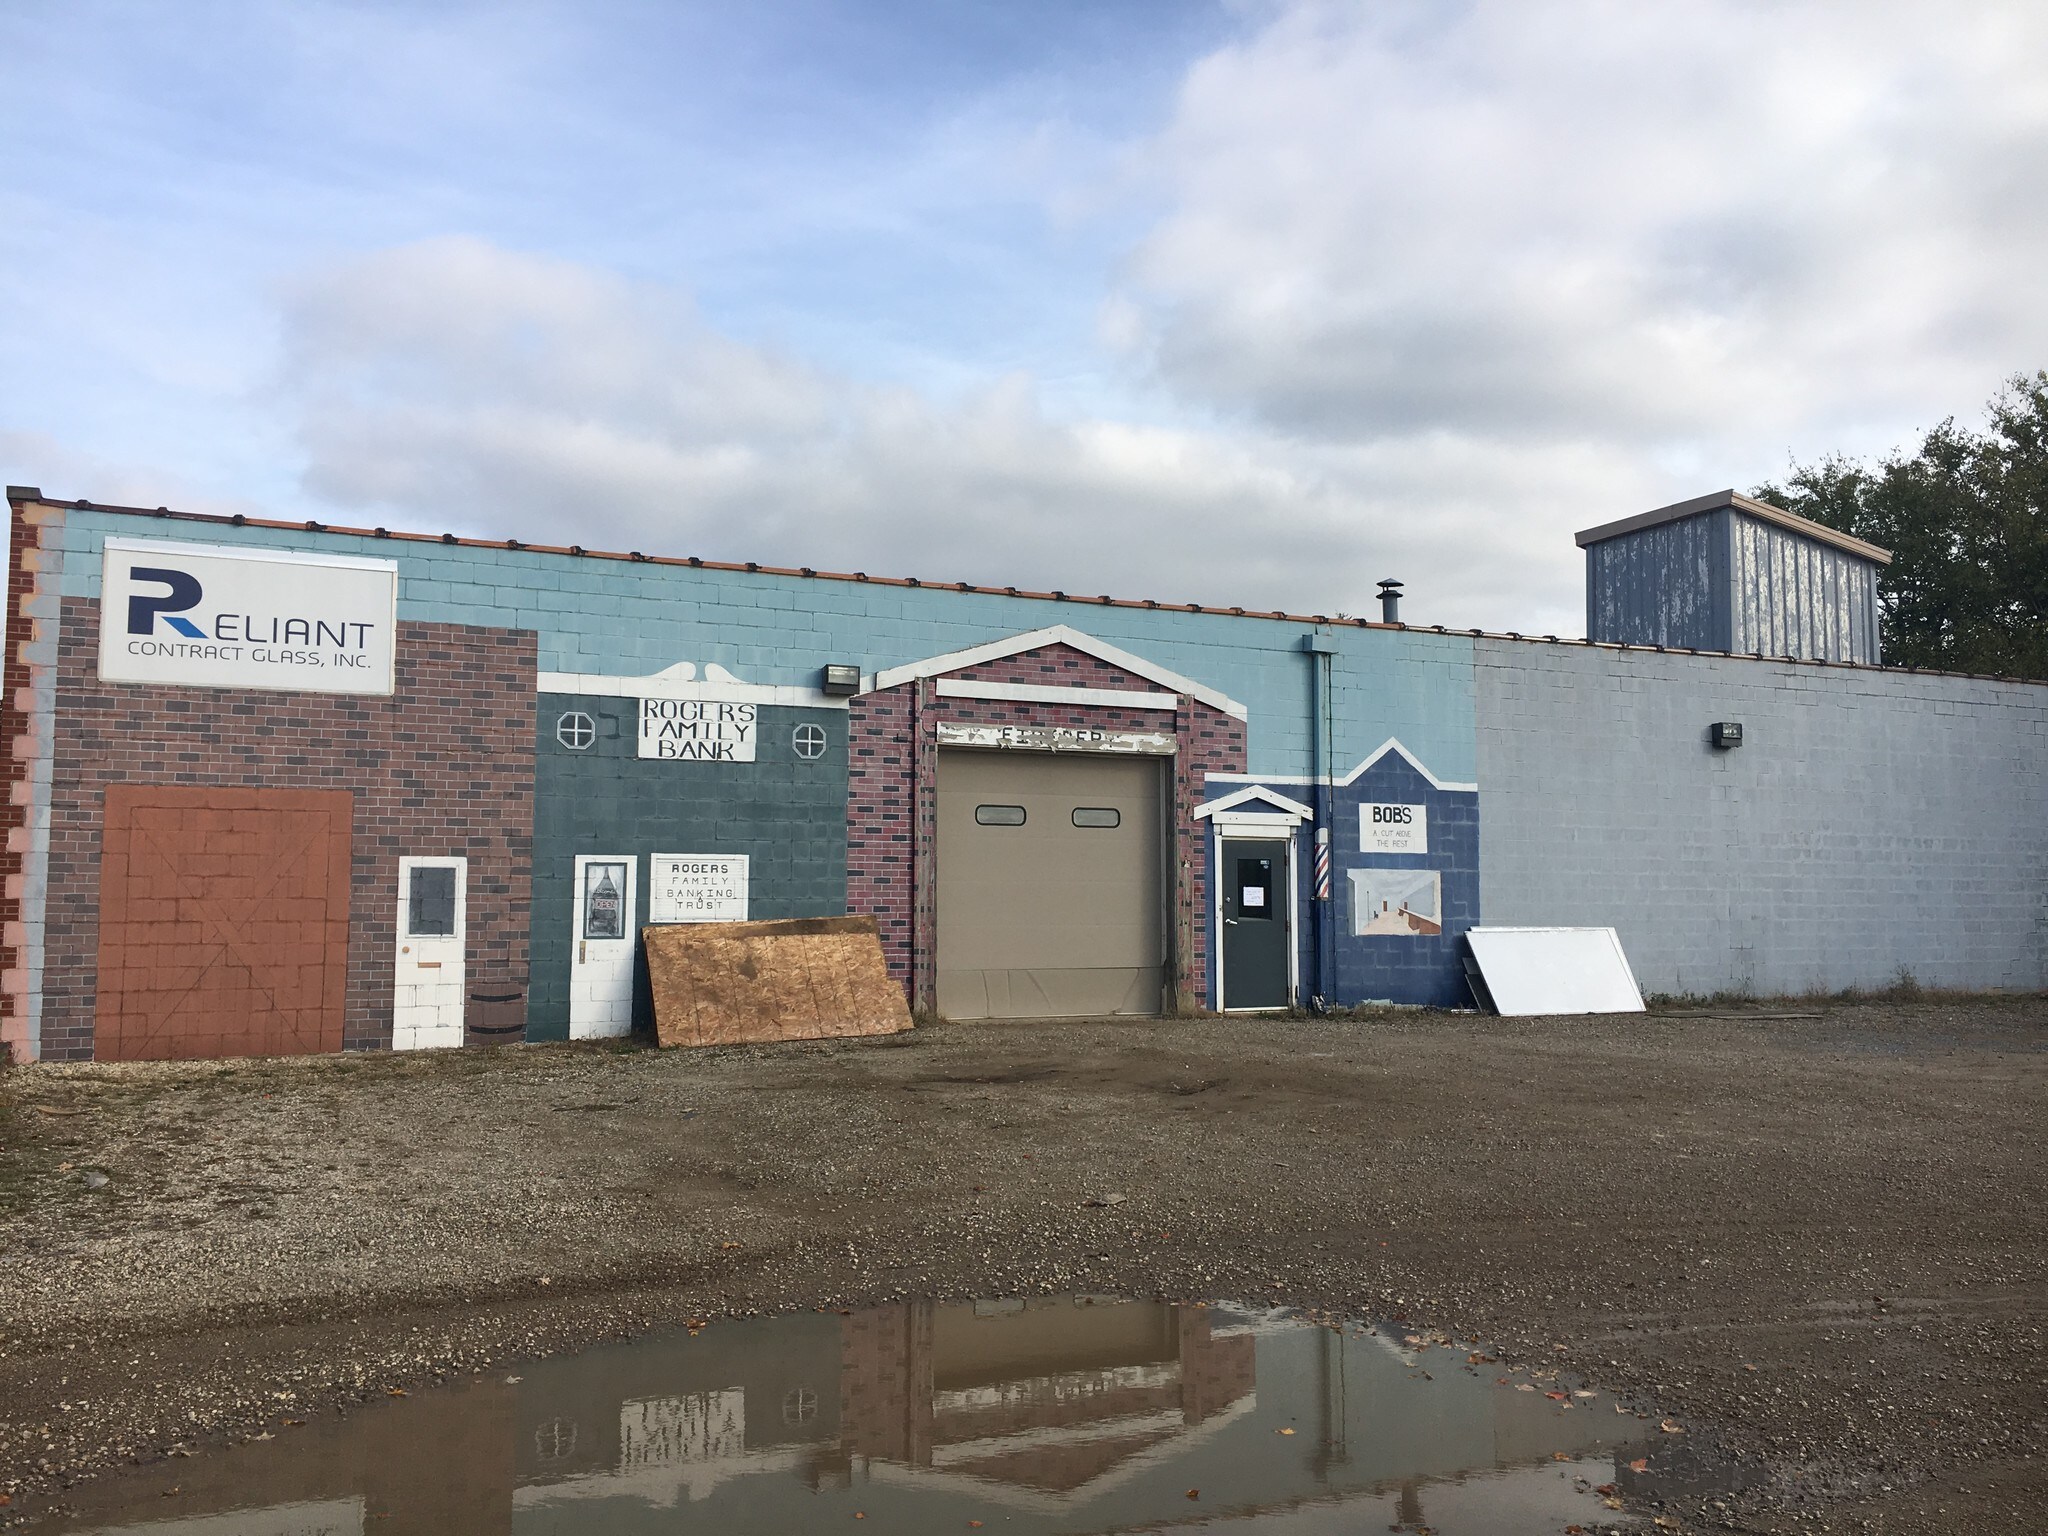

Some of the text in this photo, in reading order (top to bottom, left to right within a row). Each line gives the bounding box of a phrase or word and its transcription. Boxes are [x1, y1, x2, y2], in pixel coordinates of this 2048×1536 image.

[127, 566, 374, 649] RELIANT
[127, 641, 371, 669] CONTRACT GLASS, INC.
[644, 699, 755, 722] ROGERS
[644, 719, 749, 742] FAMILY
[658, 740, 734, 760] BANK
[1372, 805, 1412, 824] BOB'S
[1396, 830, 1411, 838] ABOVE
[671, 864, 728, 873] ROGERS
[672, 877, 728, 885] FAMILY
[667, 889, 733, 898] BANKING
[677, 901, 723, 910] TRUST
